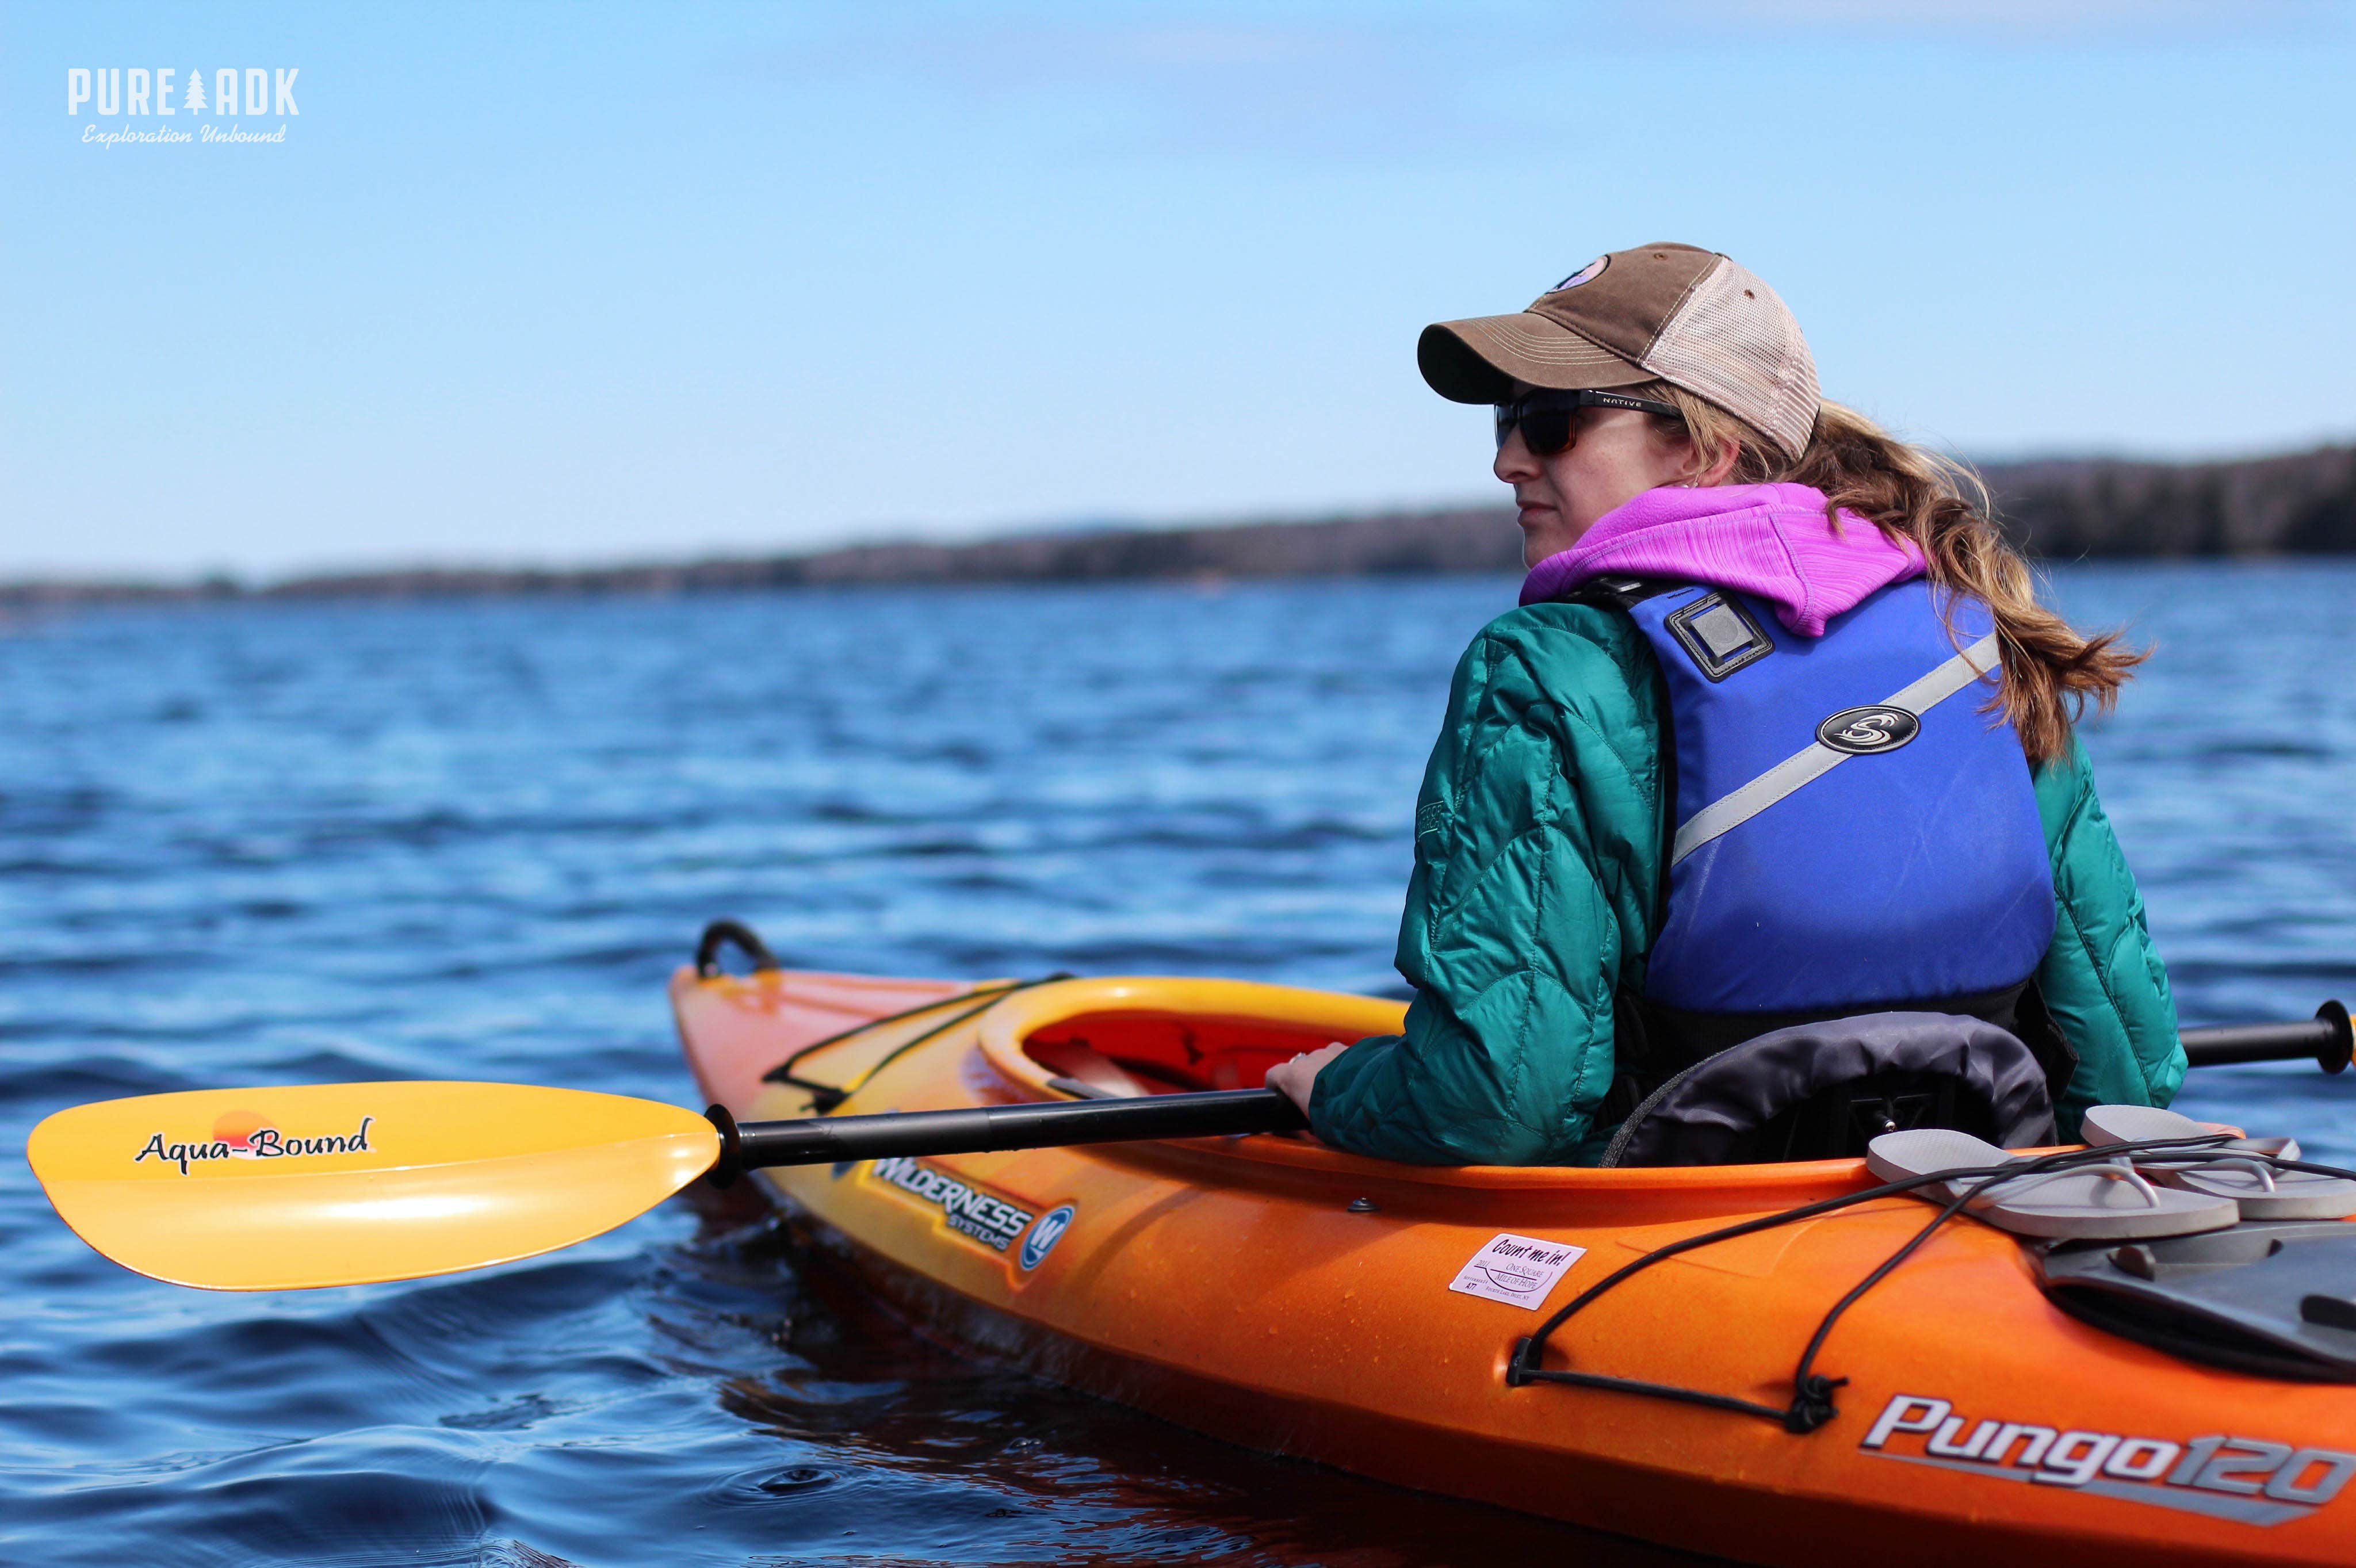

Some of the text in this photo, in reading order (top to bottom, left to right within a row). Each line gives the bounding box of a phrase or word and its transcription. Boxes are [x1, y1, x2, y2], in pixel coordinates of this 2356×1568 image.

[1602, 397, 1642, 407] NATIVE
[133, 1116, 375, 1175] Aqua-Bound
[871, 1157, 1034, 1237] WILDERNESS
[947, 1213, 1011, 1251] SYSTEMS
[1491, 1239, 1571, 1267] Count me in!
[1860, 1393, 2356, 1506] Pungo 120
